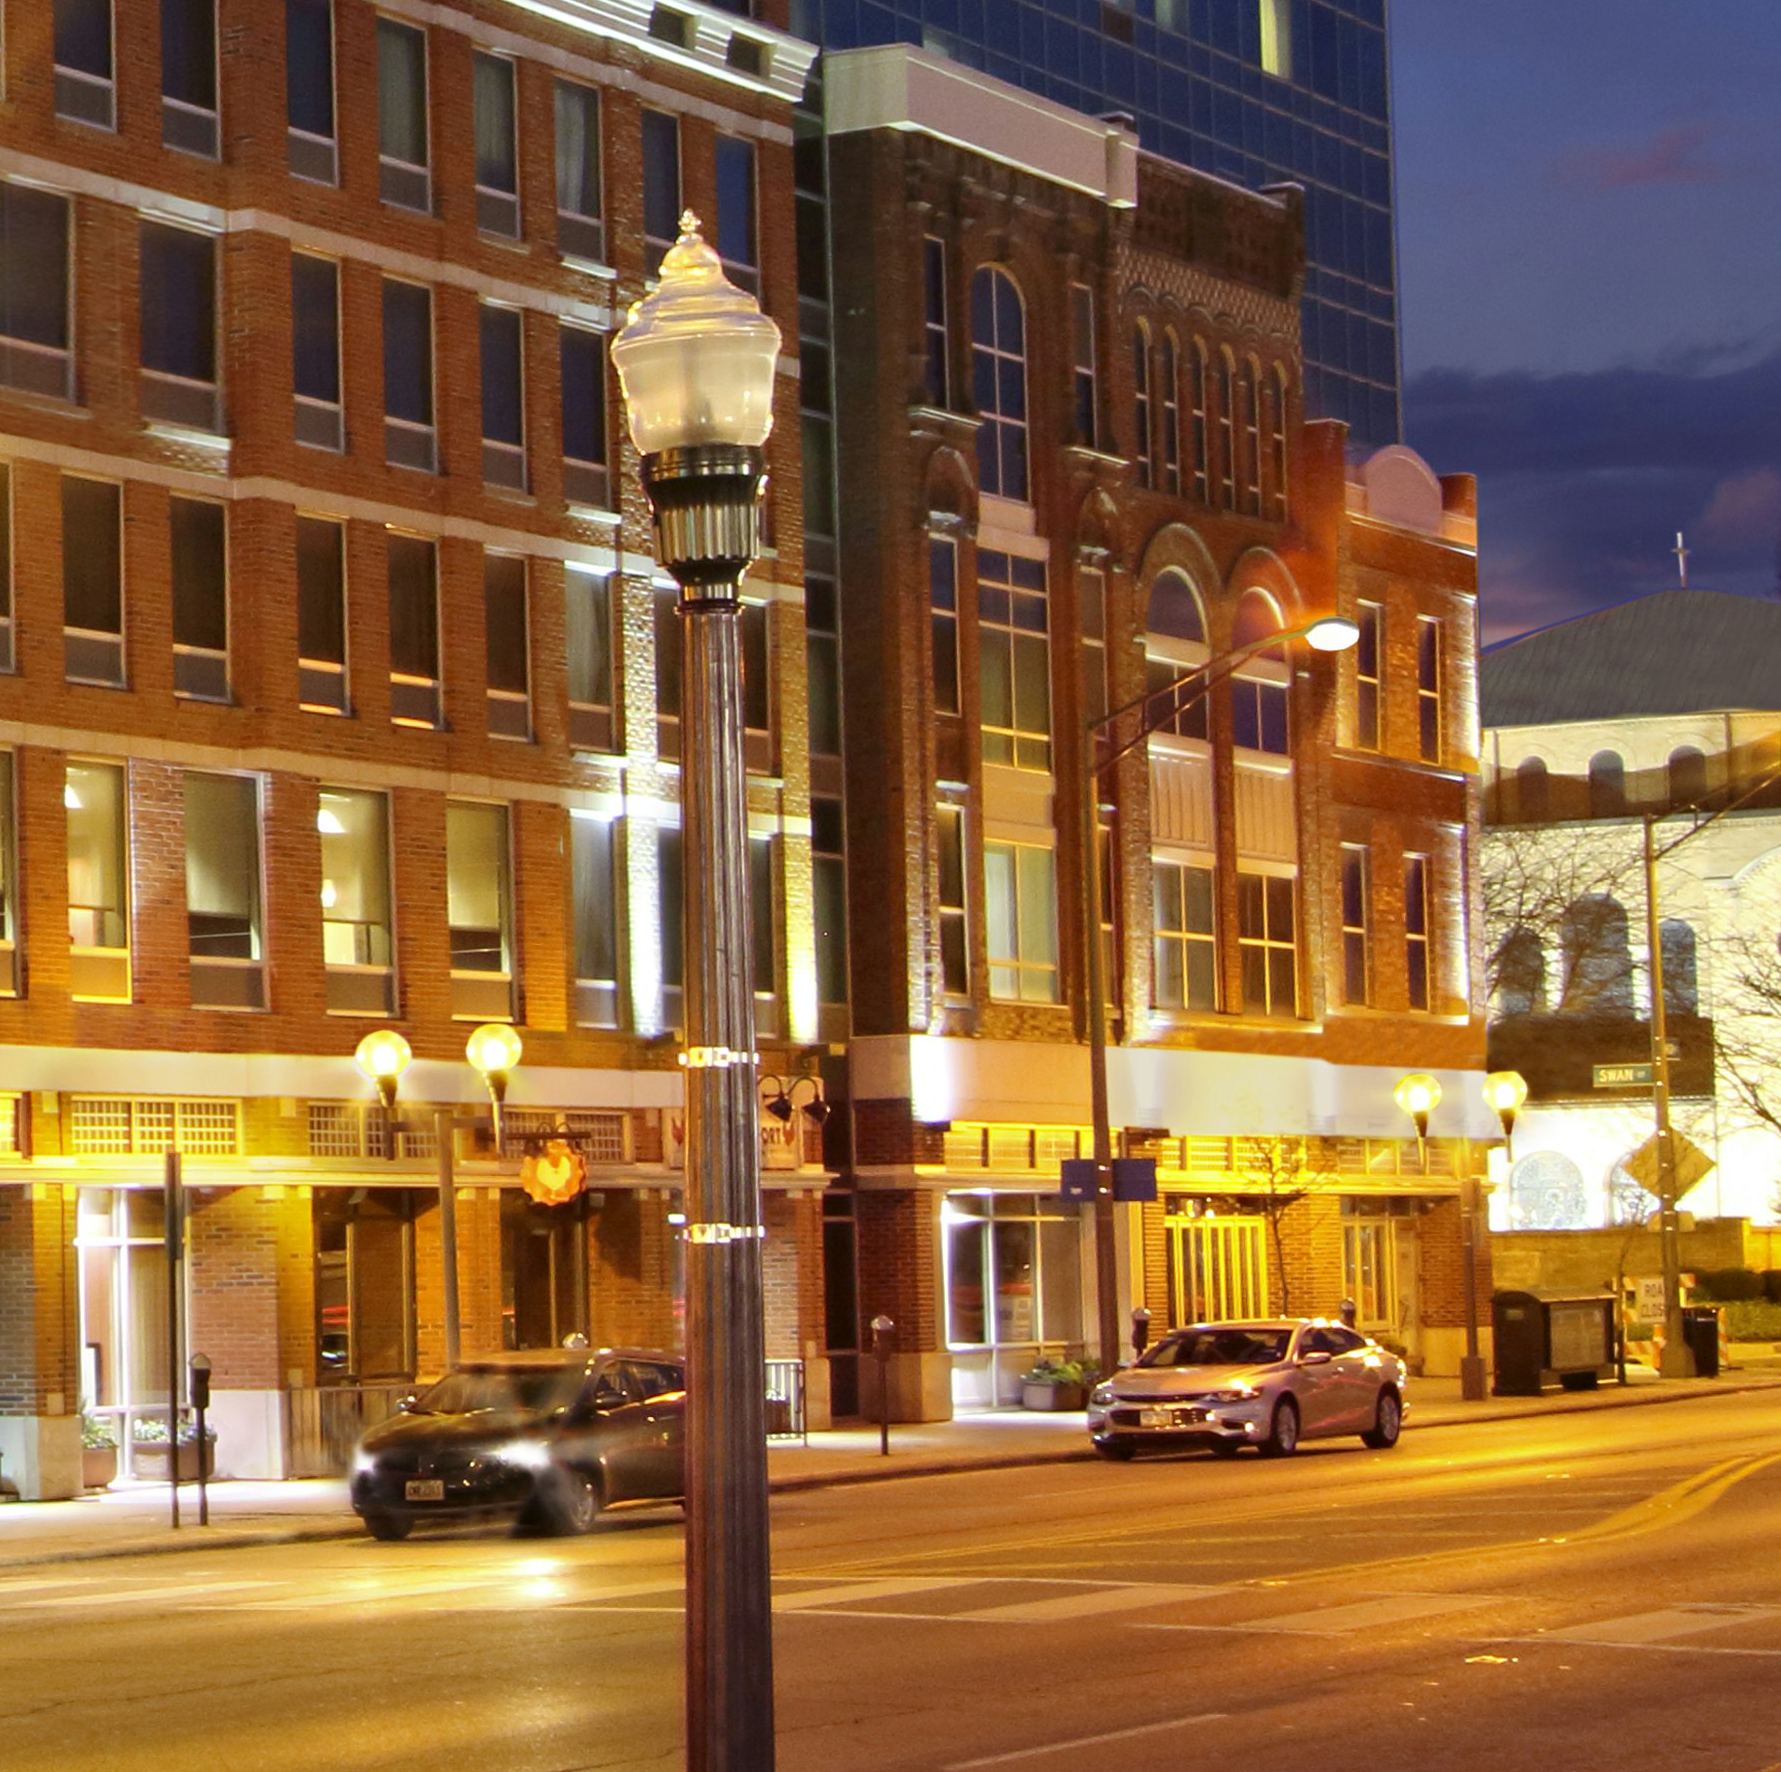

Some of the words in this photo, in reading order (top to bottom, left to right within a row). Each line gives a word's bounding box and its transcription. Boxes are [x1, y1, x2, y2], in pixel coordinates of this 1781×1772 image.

[1598, 1069, 1634, 1082] SWAN
[1644, 1283, 1664, 1298] ROA
[1641, 1303, 1664, 1318] CLOS
